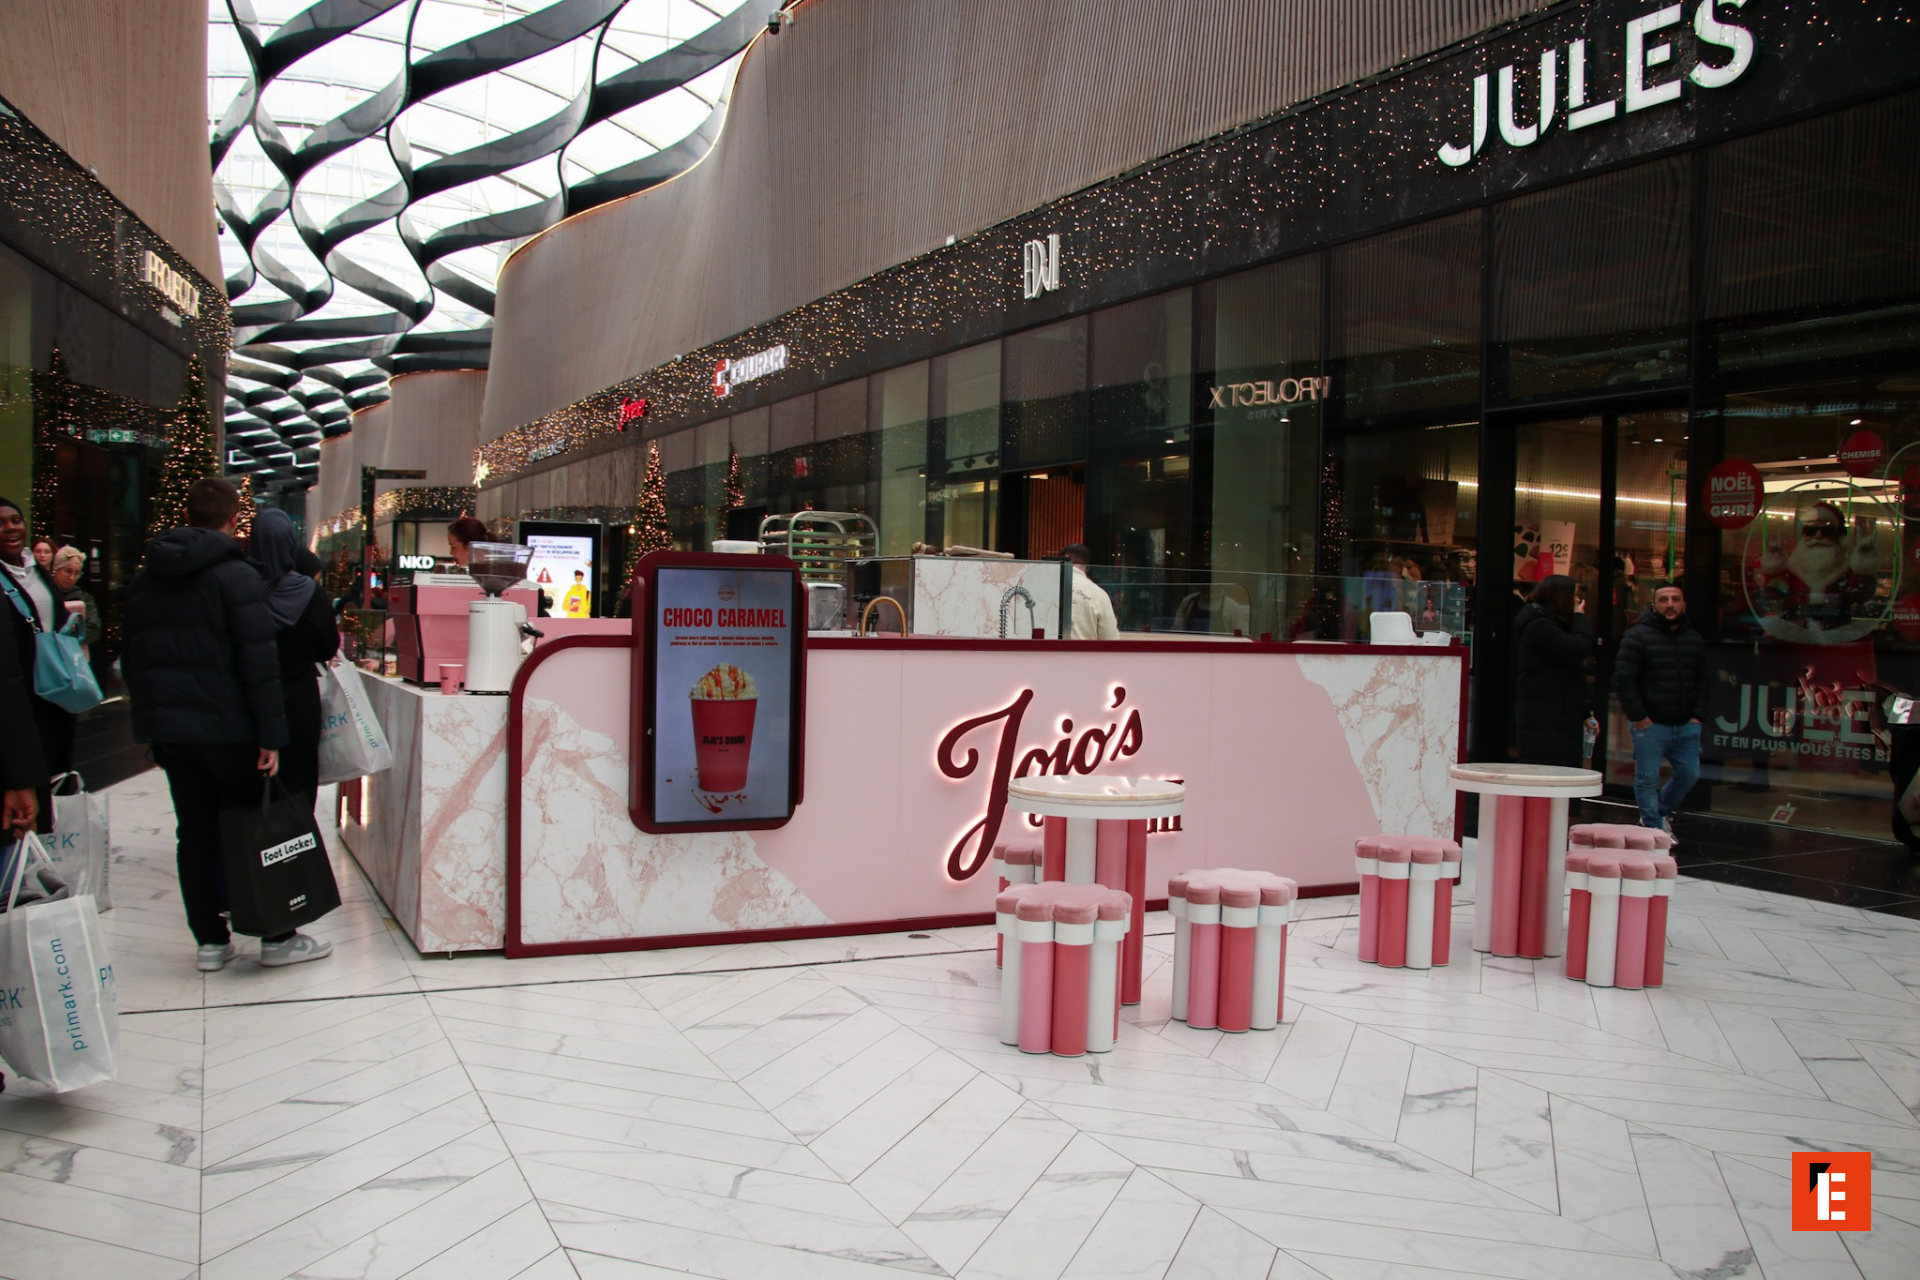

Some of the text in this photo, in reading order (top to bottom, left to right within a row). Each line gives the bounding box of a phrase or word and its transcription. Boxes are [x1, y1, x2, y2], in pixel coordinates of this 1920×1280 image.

[1437, 0, 1754, 167] JULES
[1841, 449, 1881, 460] CHEMISE
[1710, 472, 1755, 492] NOËL
[399, 555, 434, 569] NKD
[663, 607, 787, 628] CHOCO CARAMEL
[1893, 613, 1920, 621] PANTA
[1713, 735, 1729, 746] ET
[1732, 737, 1749, 749] EN
[1752, 738, 1787, 752] PLUS
[1790, 742, 1831, 757] VOUS
[263, 848, 283, 863] Foot
[284, 838, 313, 855] Locker
[50, 938, 88, 1051] primark.com
